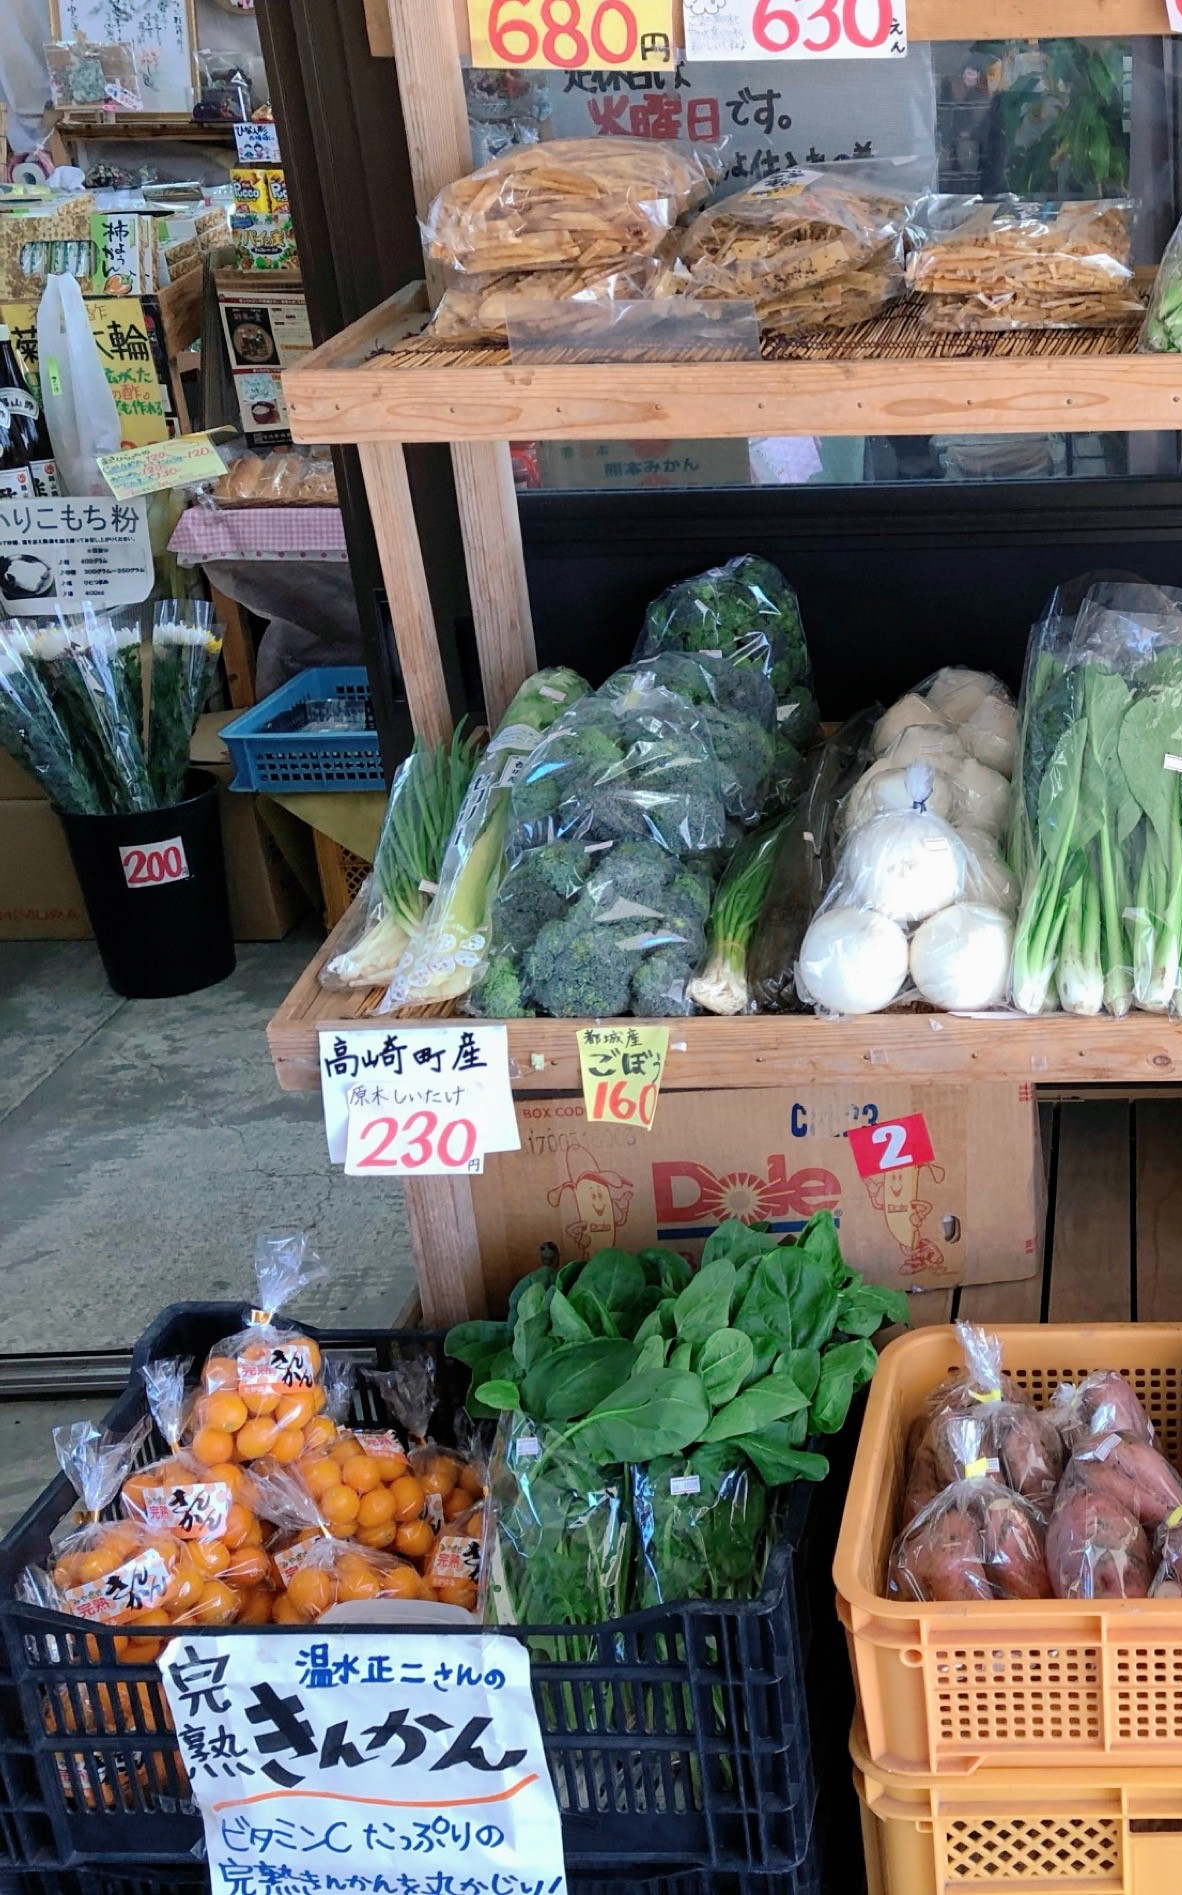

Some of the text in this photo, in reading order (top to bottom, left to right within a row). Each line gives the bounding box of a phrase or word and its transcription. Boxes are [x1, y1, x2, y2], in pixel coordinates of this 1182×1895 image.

[324, 1031, 488, 1078] 高崎町産
[588, 1049, 662, 1083] ごぼう
[350, 1085, 465, 1106] 原木しいたけ
[523, 1108, 551, 1119] BOX
[357, 1110, 482, 1173] 230円
[872, 1125, 913, 1170] 2
[652, 1154, 842, 1226] Dole
[294, 1643, 506, 1691] 温水正二さんの
[243, 1682, 528, 1788] きんかん
